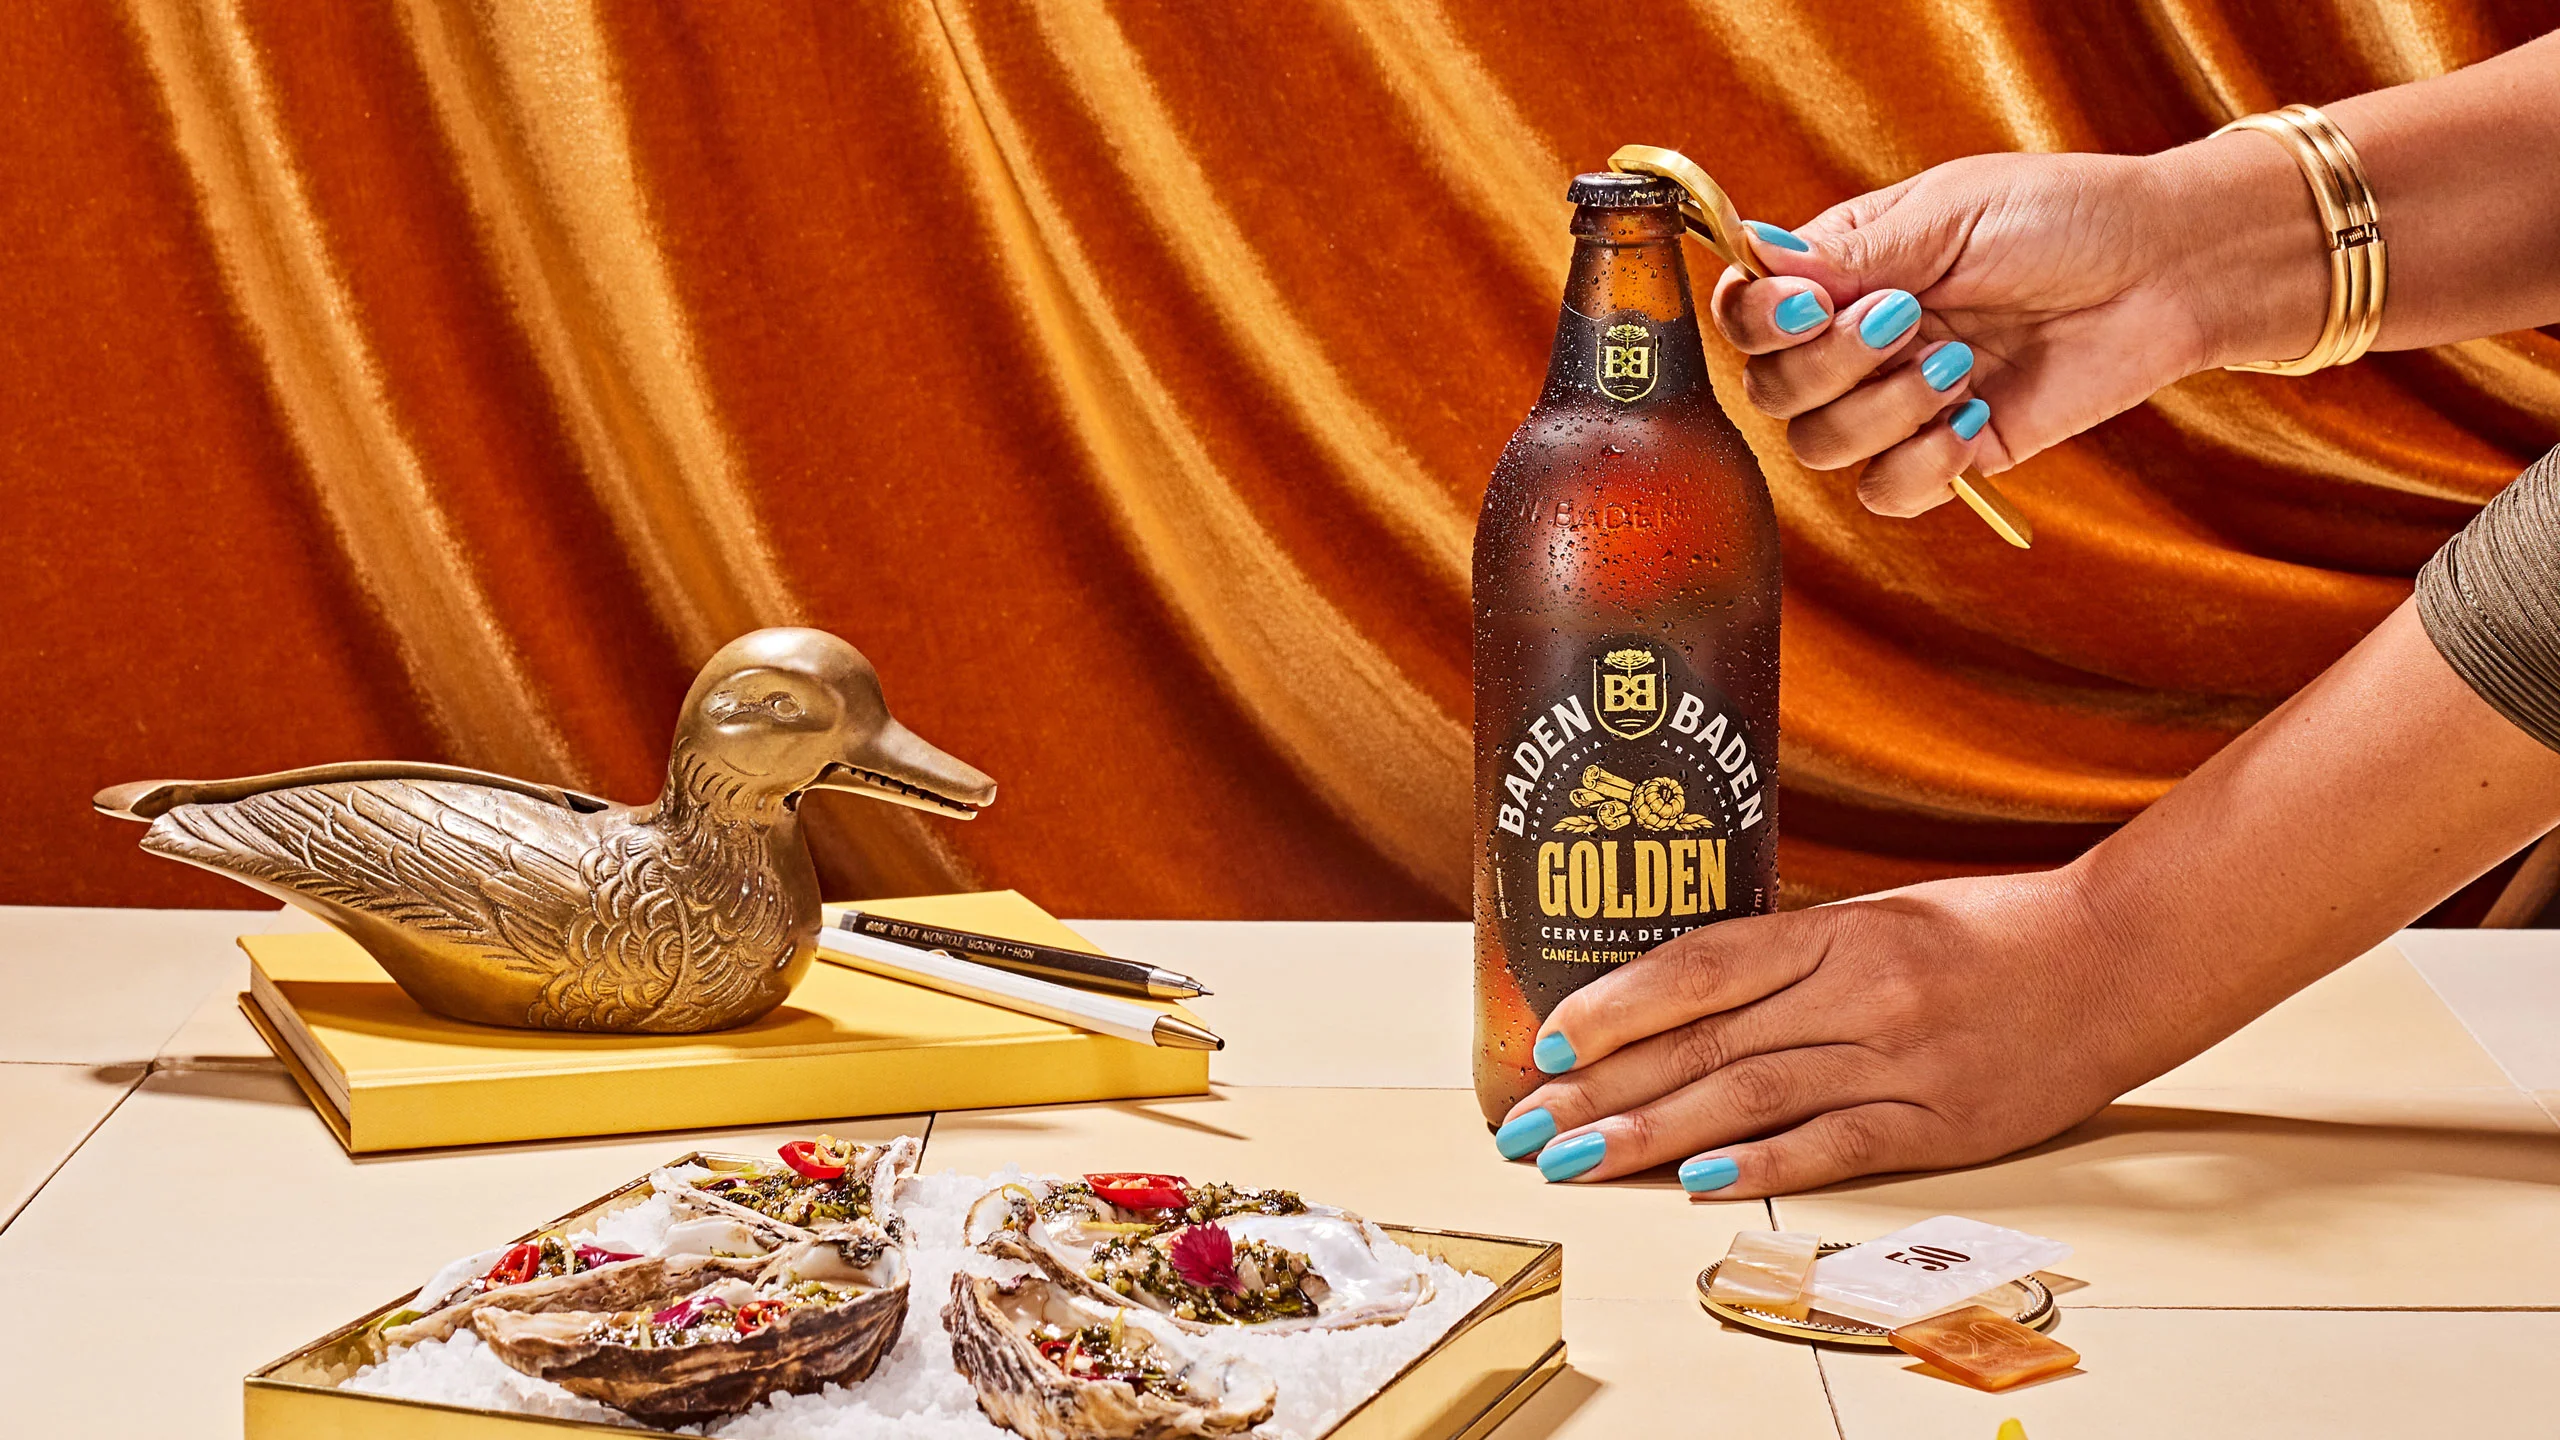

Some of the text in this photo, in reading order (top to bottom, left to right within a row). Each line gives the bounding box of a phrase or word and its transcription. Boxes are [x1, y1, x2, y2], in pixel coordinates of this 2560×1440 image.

[1498, 691, 1763, 837] BADEN BADEN
[1530, 739, 1733, 841] CERVEJARIA ARTESANAL
[1537, 839, 1727, 919] GOLDEN
[1541, 926, 1630, 942] CERVEJA
[1638, 927, 1663, 941] DE
[1541, 947, 1590, 963] CANELA
[1885, 1245, 1971, 1271] 50
